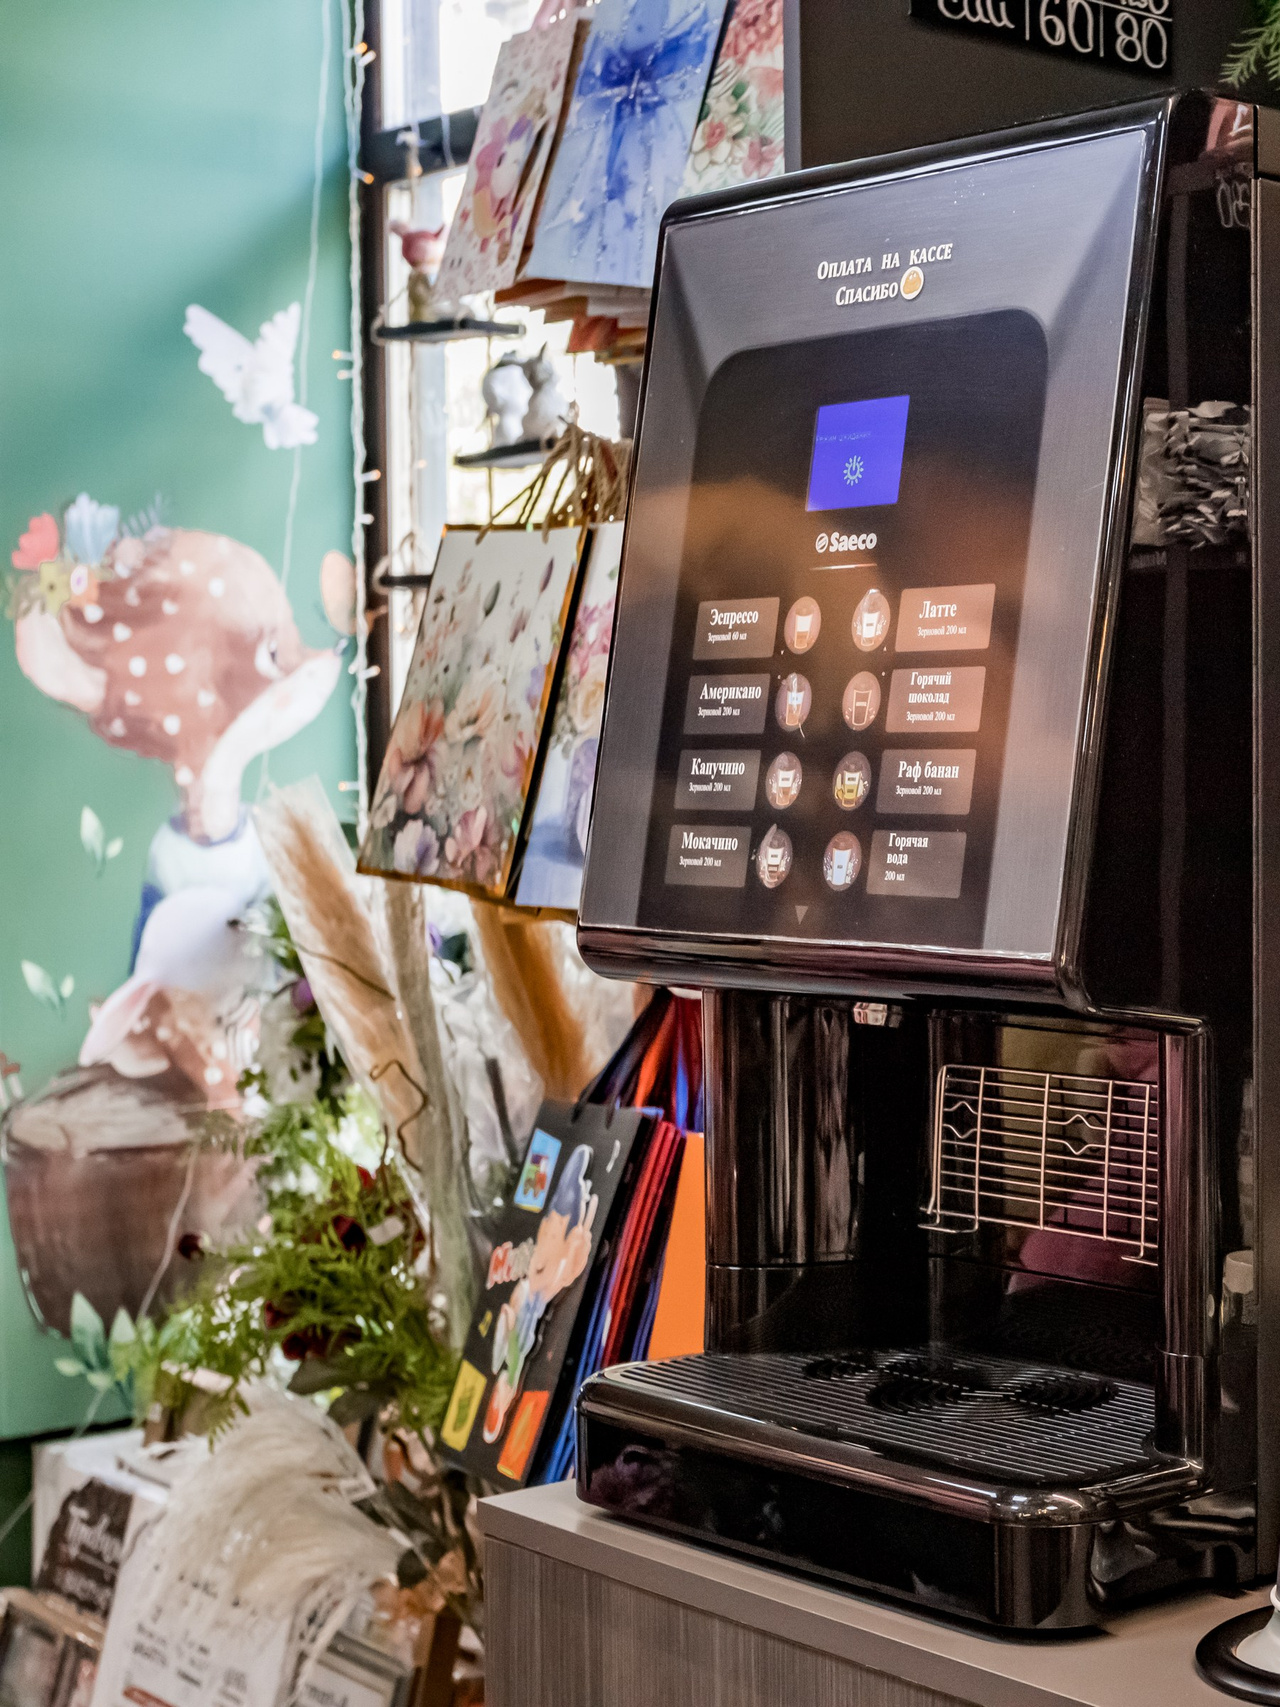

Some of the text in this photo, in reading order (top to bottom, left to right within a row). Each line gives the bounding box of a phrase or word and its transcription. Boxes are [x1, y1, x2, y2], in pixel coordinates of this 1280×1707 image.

[1040, 0, 1094, 53] 60
[1115, 12, 1167, 69] 80
[829, 531, 878, 553] Saeco
[919, 600, 957, 619] Латте
[709, 608, 759, 629] Эспрессо
[732, 631, 739, 641] 60
[945, 625, 957, 635] 200
[910, 671, 952, 689] Горячий
[699, 683, 762, 704] Американо
[908, 692, 950, 704] шоколад
[722, 706, 732, 716] 200
[934, 711, 946, 721] 200
[690, 757, 745, 779] Капучино
[898, 760, 960, 783] Раф банан
[713, 782, 723, 792] 200
[922, 786, 934, 795] 200
[681, 831, 738, 851] Мокачино
[888, 832, 929, 850] Горячая
[703, 856, 713, 866] 200
[886, 853, 908, 865] вода
[884, 870, 896, 881] 200
